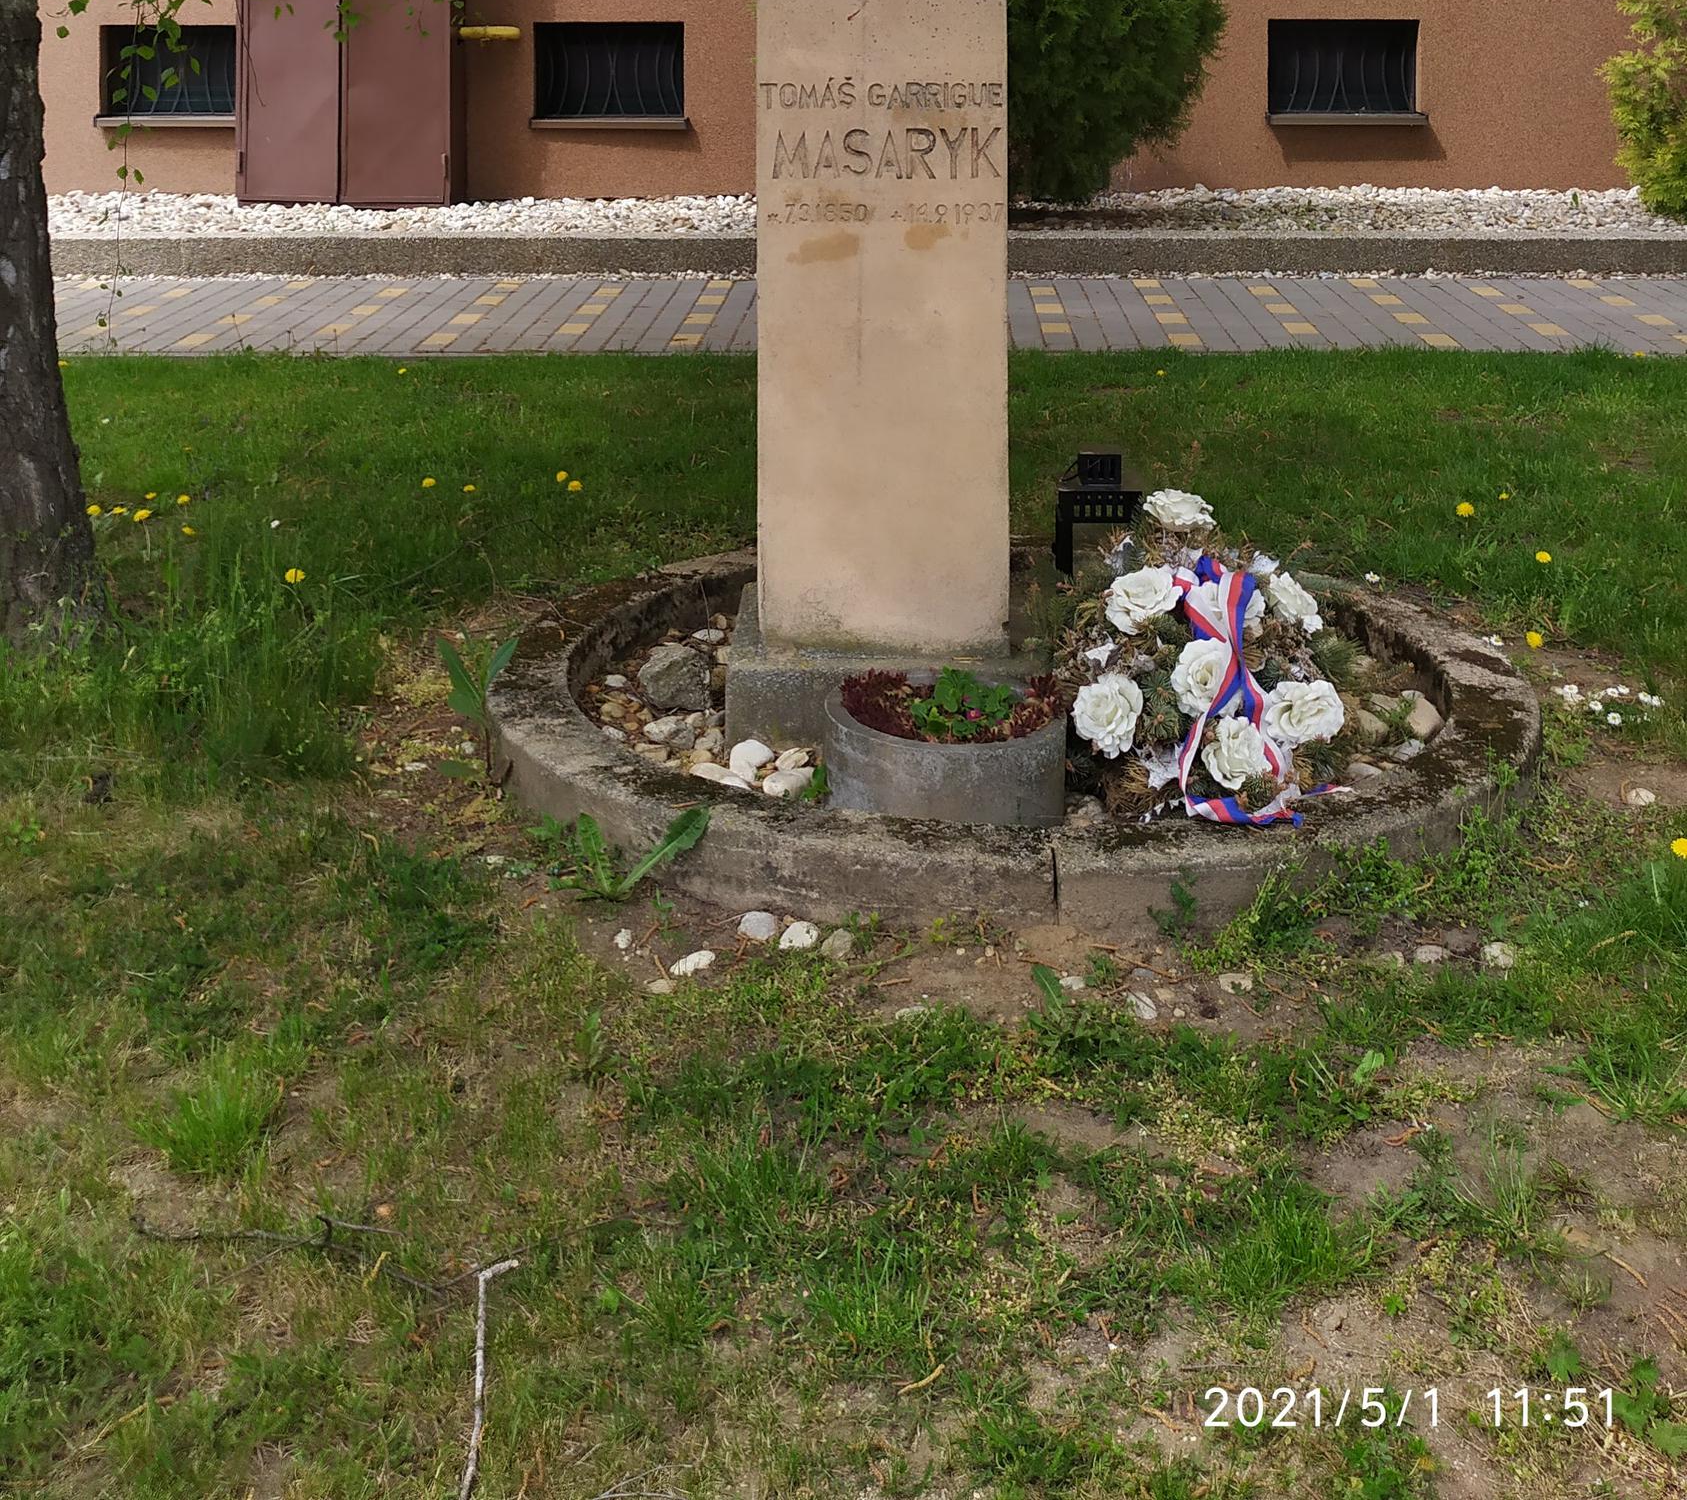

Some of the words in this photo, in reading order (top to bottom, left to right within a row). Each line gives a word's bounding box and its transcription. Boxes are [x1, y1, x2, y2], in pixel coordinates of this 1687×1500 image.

[759, 77, 857, 110] TOMÁŠ
[867, 82, 1003, 111] GARRIGUE
[772, 127, 1002, 180] MASARYK
